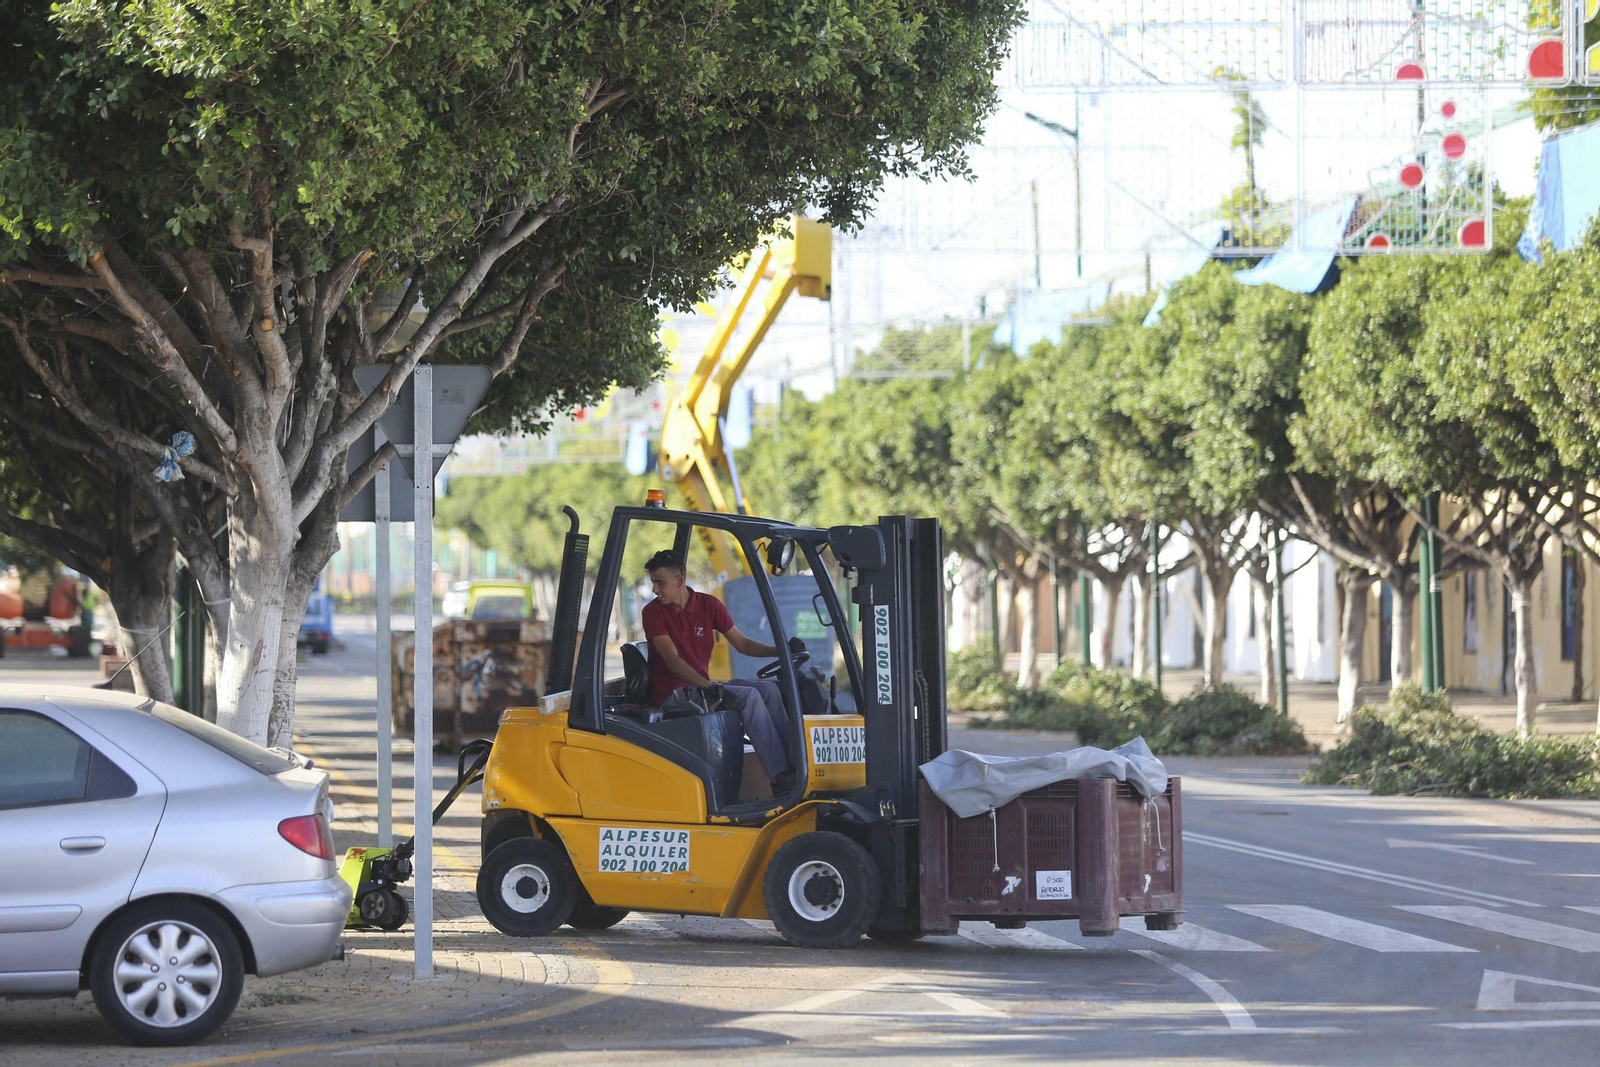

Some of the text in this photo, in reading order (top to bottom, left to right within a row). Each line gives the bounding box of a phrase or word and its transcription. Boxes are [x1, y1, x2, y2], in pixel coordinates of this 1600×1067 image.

[875, 608, 891, 702] 902 100 204
[813, 727, 866, 744] ALPESUR
[816, 746, 832, 762] 902
[834, 746, 850, 762] 100
[602, 829, 688, 843] ALPESUR
[601, 844, 688, 859] ALQUILER
[601, 858, 687, 873] 902 100 204
